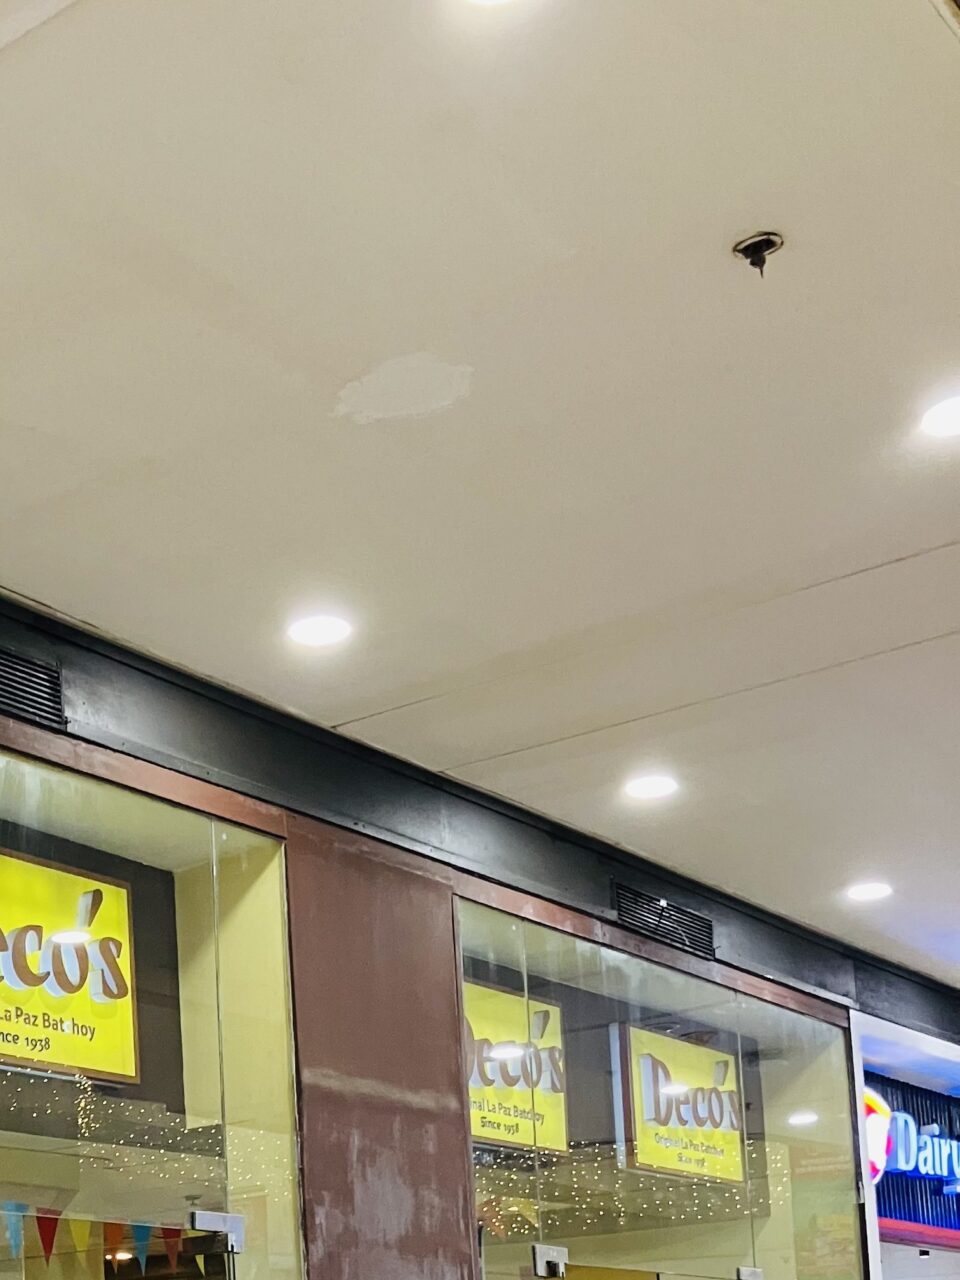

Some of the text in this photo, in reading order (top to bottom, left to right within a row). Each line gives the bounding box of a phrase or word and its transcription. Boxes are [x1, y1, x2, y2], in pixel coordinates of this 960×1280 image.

[15, 1006, 39, 1027] Paz
[42, 1012, 96, 1042] Bathoy
[24, 1036, 51, 1052] 1938
[486, 1099, 497, 1114] La
